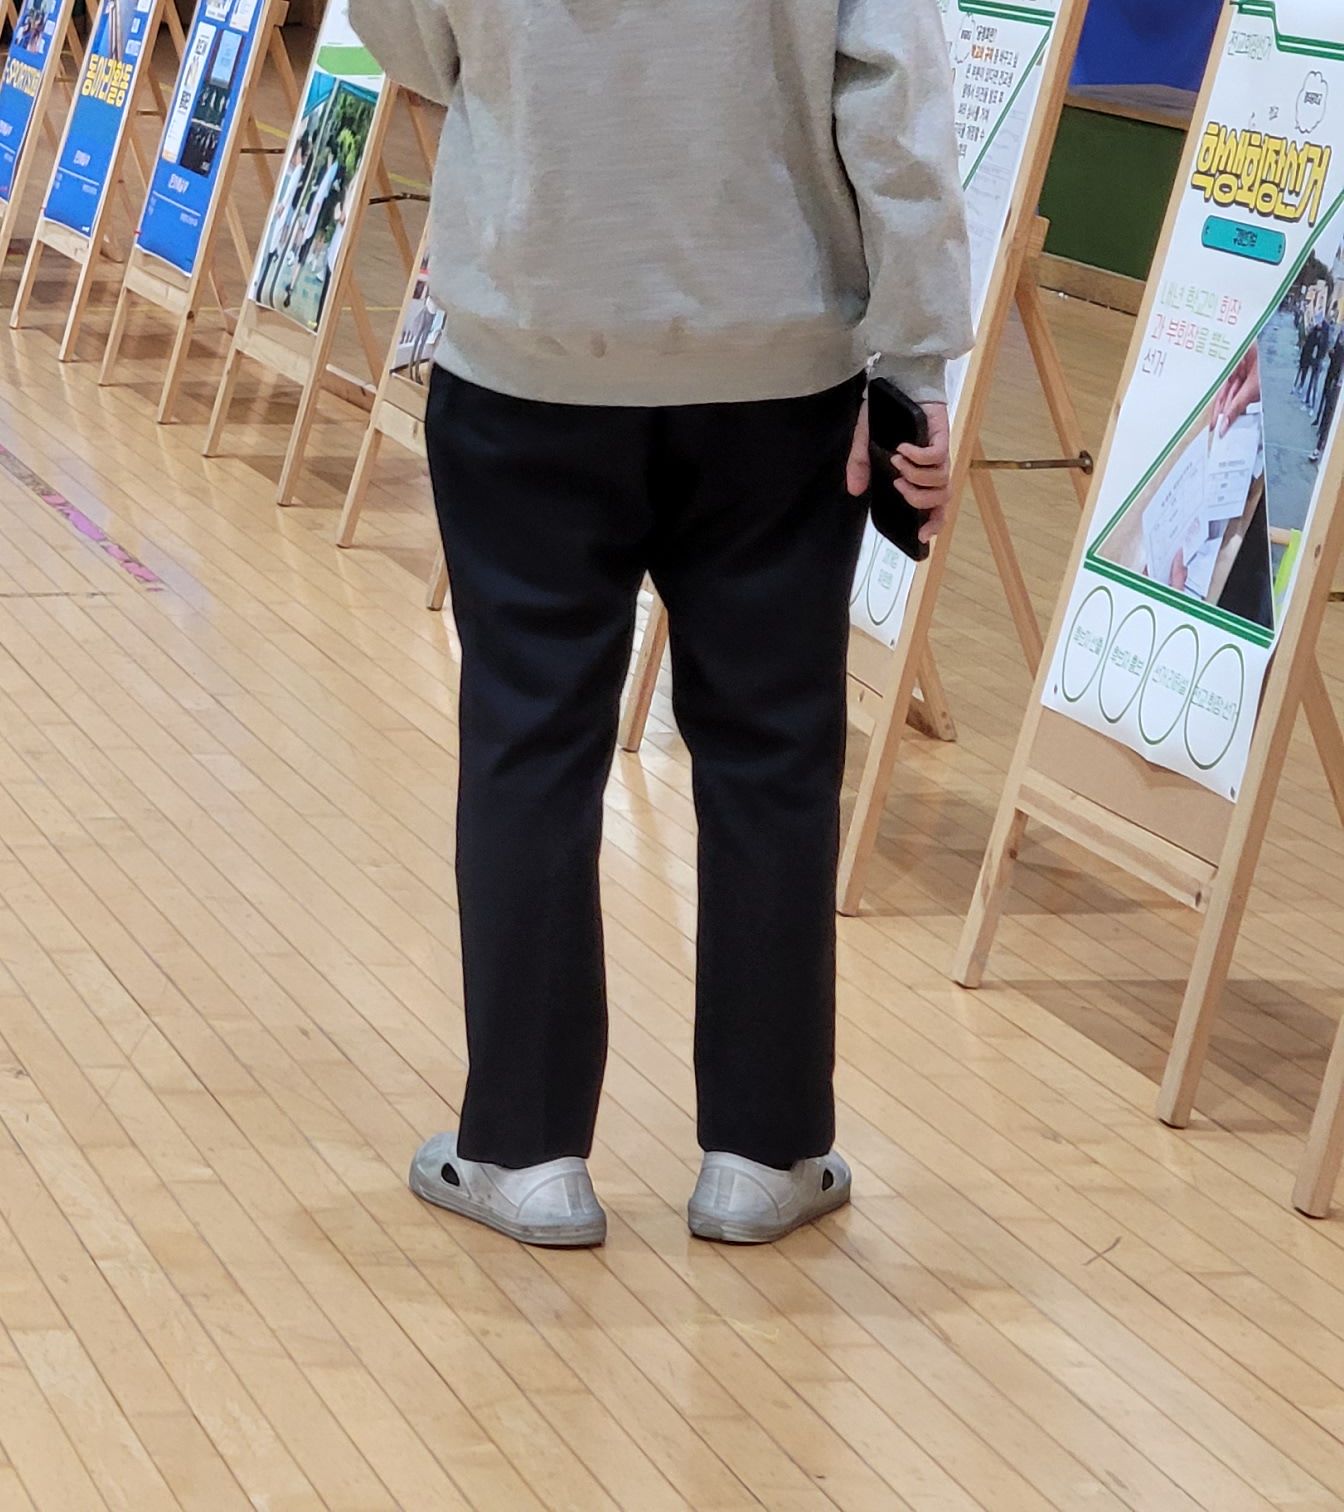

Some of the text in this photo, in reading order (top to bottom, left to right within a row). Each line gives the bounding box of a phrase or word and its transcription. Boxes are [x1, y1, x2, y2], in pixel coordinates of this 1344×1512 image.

[1191, 121, 1332, 229] 학생회장선거
[1217, 295, 1243, 326] 회장
[1141, 348, 1168, 378] 선거
